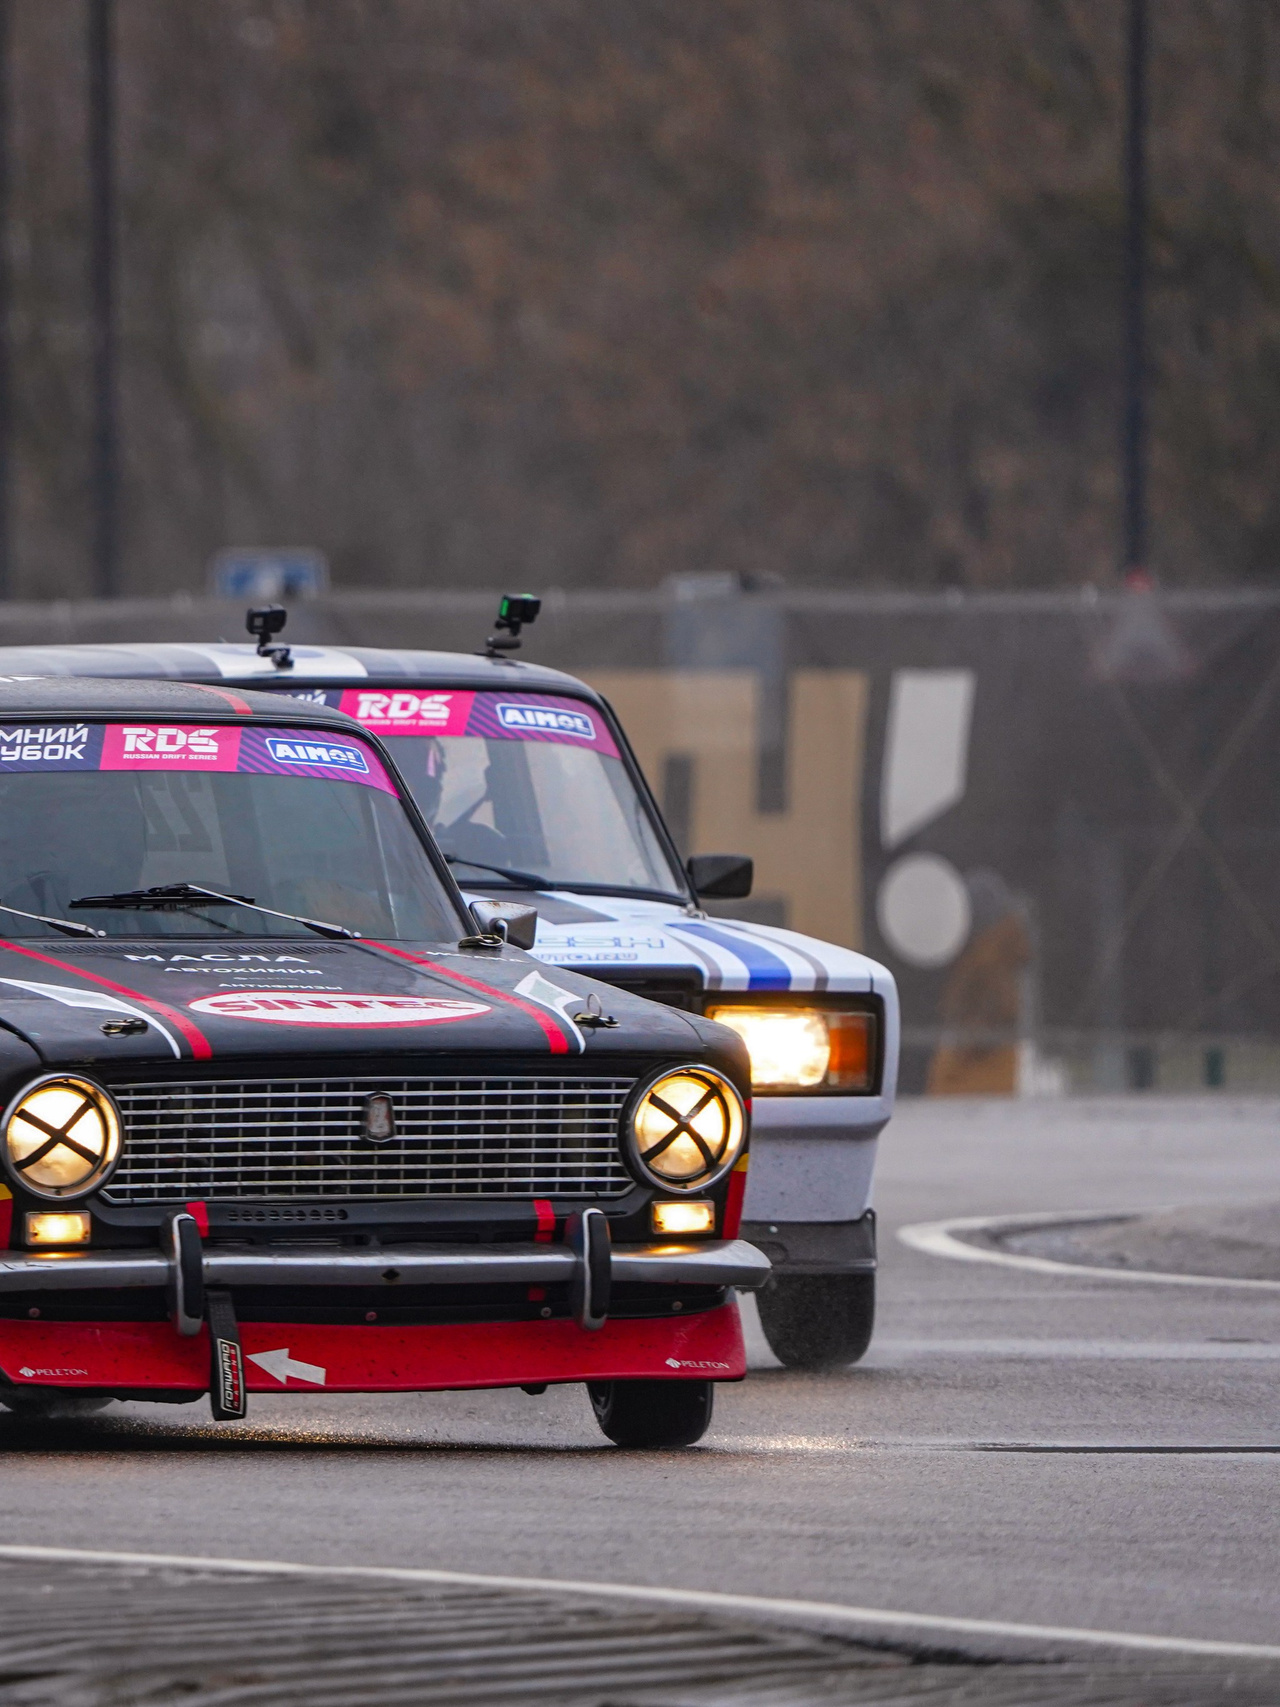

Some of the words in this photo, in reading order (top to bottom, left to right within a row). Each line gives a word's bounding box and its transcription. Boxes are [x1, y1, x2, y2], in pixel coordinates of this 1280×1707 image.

[356, 693, 453, 719] RDS
[504, 708, 590, 733] AIMOL
[122, 727, 220, 753] RDS
[275, 743, 365, 769] AIMOL
[123, 953, 311, 964] МАСЛА
[164, 966, 324, 975] АВТОХИМИЯ
[207, 998, 476, 1013] SINTEC
[35, 1368, 89, 1376] PELETON
[680, 1359, 730, 1370] PELETON
[222, 1344, 234, 1408] FORWARD
